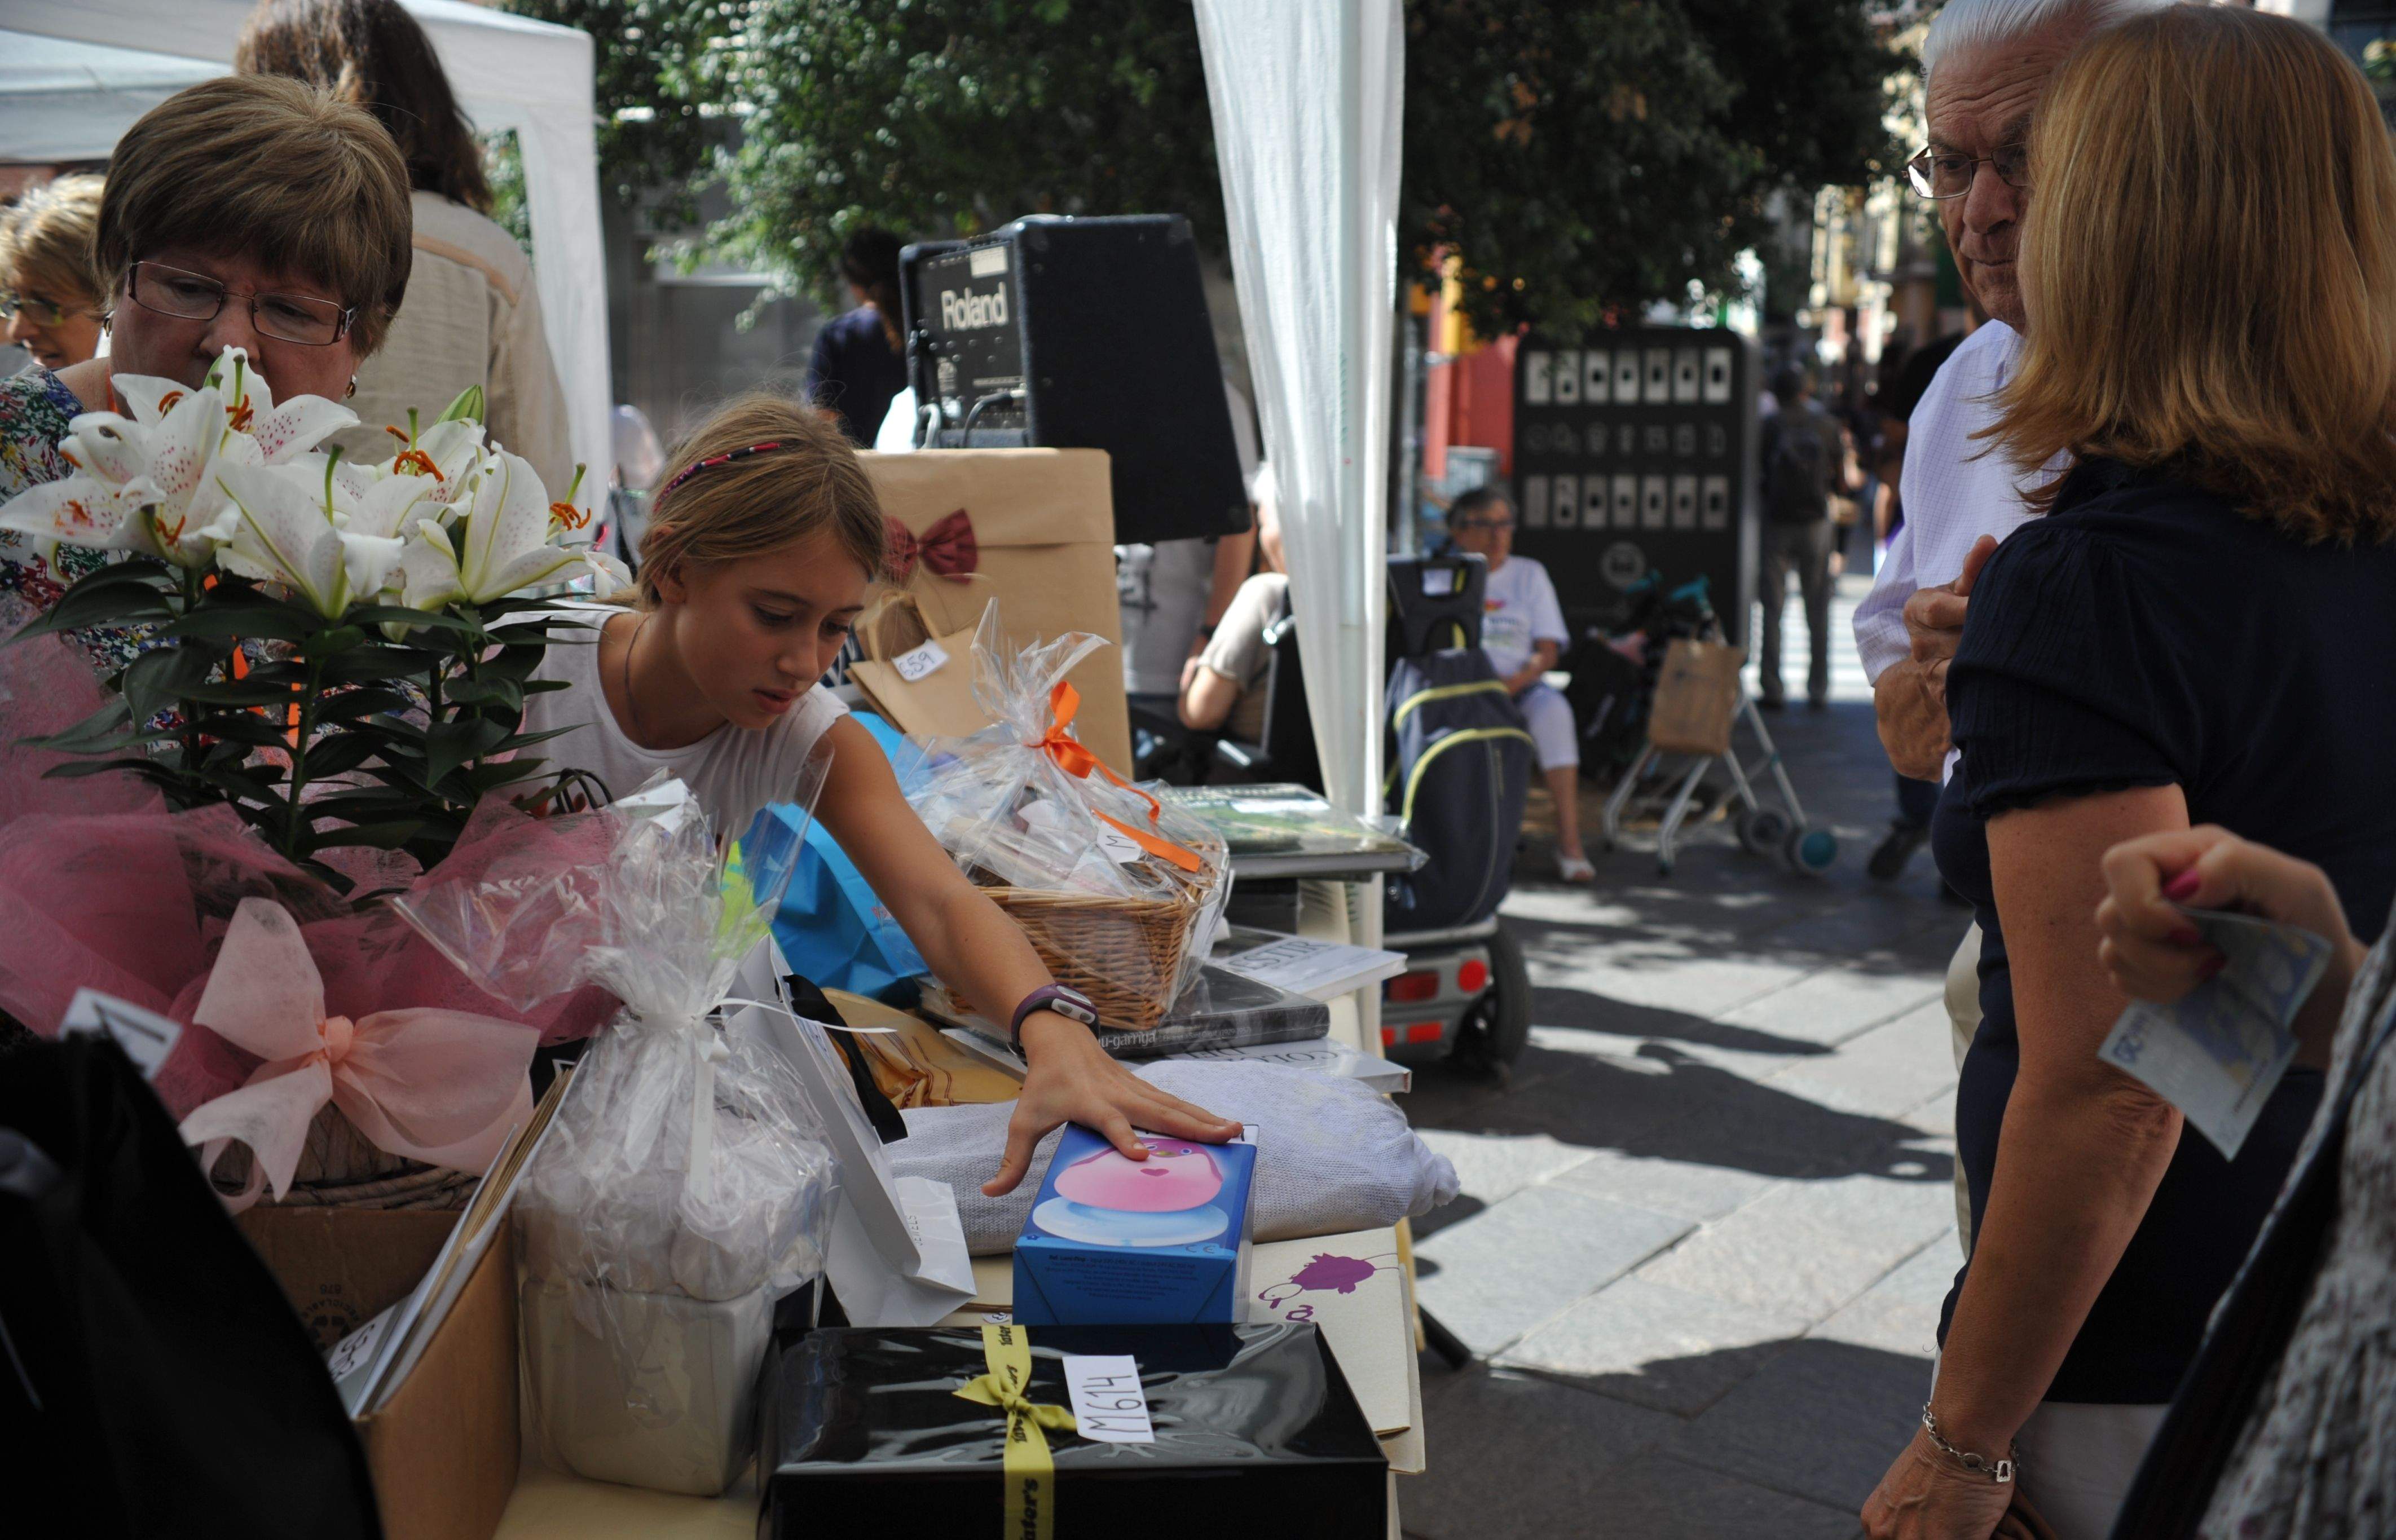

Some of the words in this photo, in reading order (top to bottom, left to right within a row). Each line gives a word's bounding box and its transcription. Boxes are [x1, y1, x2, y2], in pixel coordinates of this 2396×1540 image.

[941, 282, 1008, 332] Roland
[1227, 941, 1329, 972] ESTIR
[1099, 1031, 1156, 1049] u-garriga
[1081, 1375, 1149, 1433] M614
